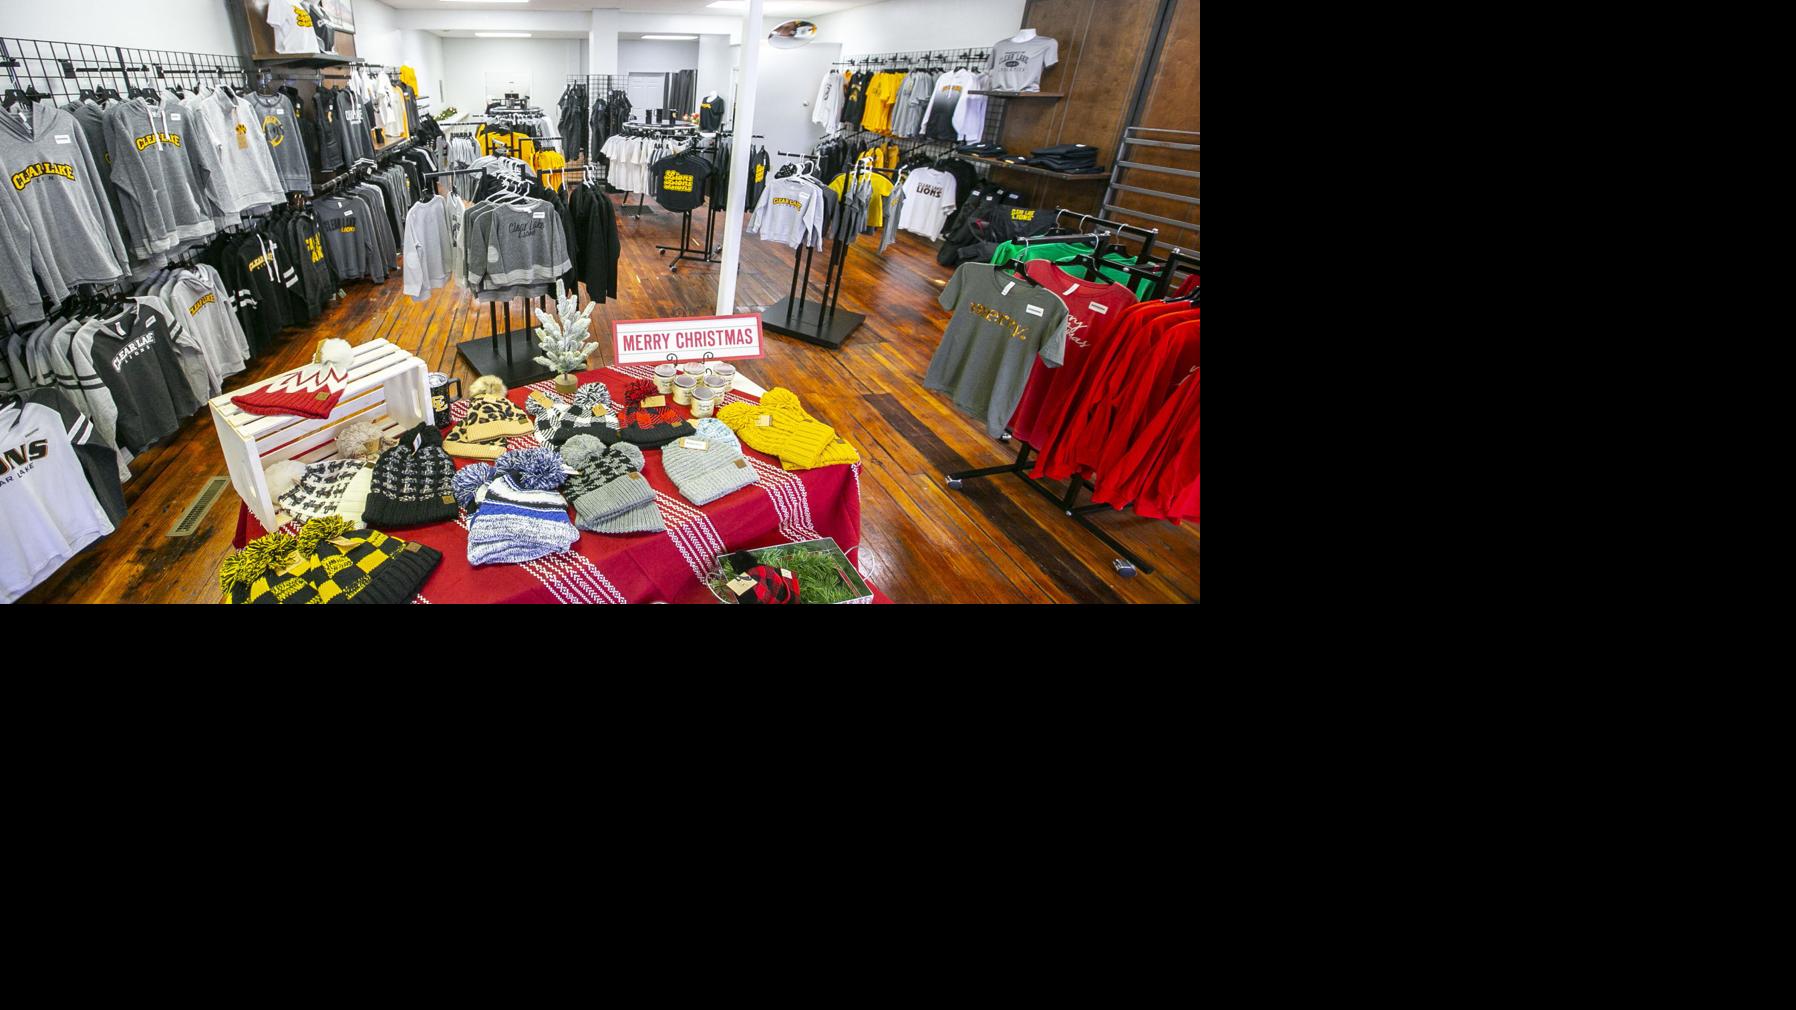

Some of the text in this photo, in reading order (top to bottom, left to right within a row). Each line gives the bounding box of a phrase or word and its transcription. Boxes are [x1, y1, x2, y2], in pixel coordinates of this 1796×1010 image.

[135, 132, 181, 151] CLEA LKE
[623, 328, 753, 352] MERRY CHRISTMAS
[112, 343, 137, 373] CLEAR
[17, 462, 34, 479] LAKE
